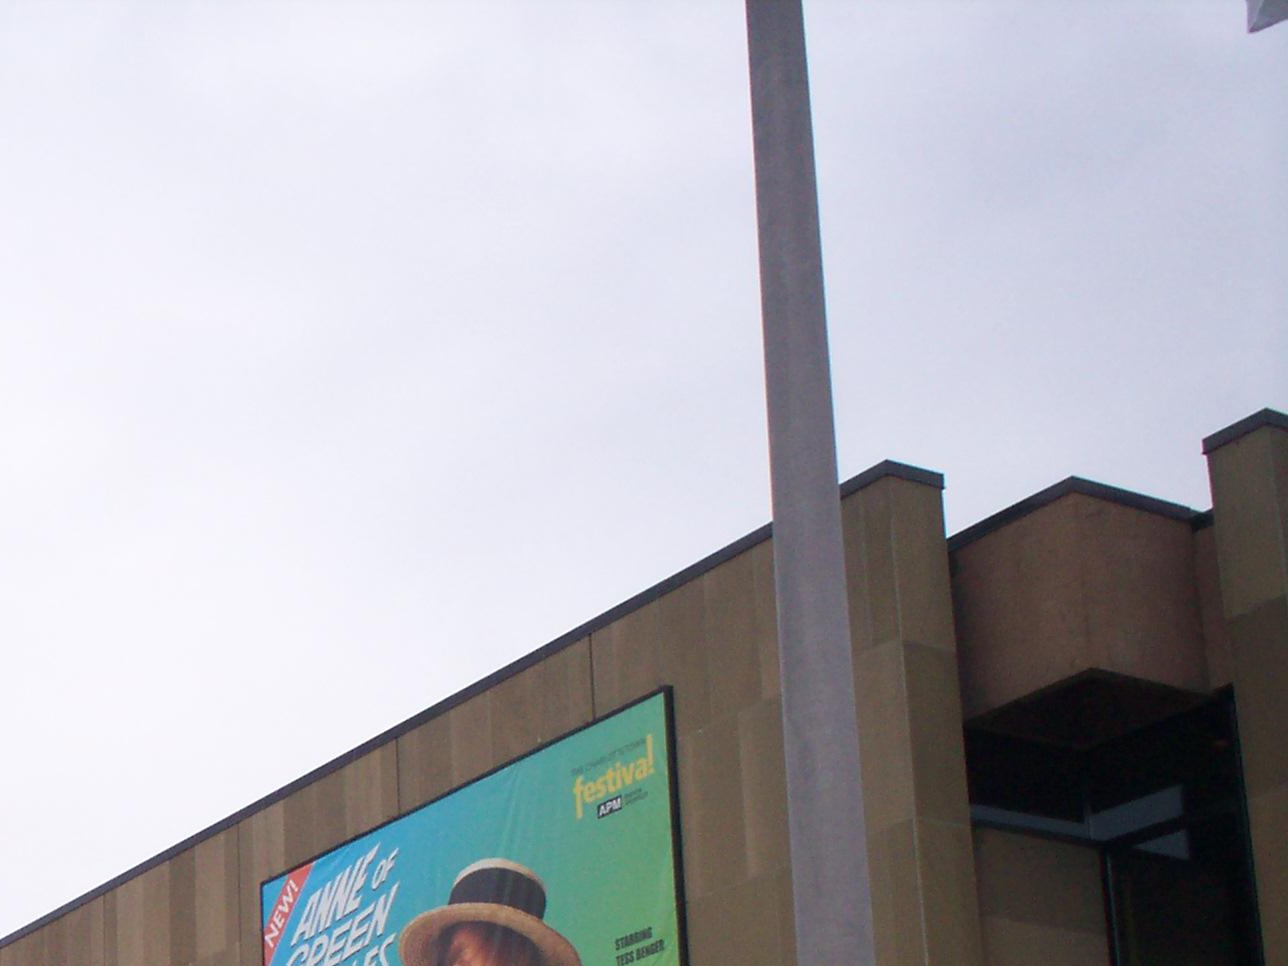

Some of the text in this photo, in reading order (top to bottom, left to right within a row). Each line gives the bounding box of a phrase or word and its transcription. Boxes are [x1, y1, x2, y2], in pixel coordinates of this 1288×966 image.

[573, 733, 655, 820] festival
[599, 797, 622, 816] APM
[264, 879, 299, 949] NEW!
[291, 842, 399, 948] ANNE OF
